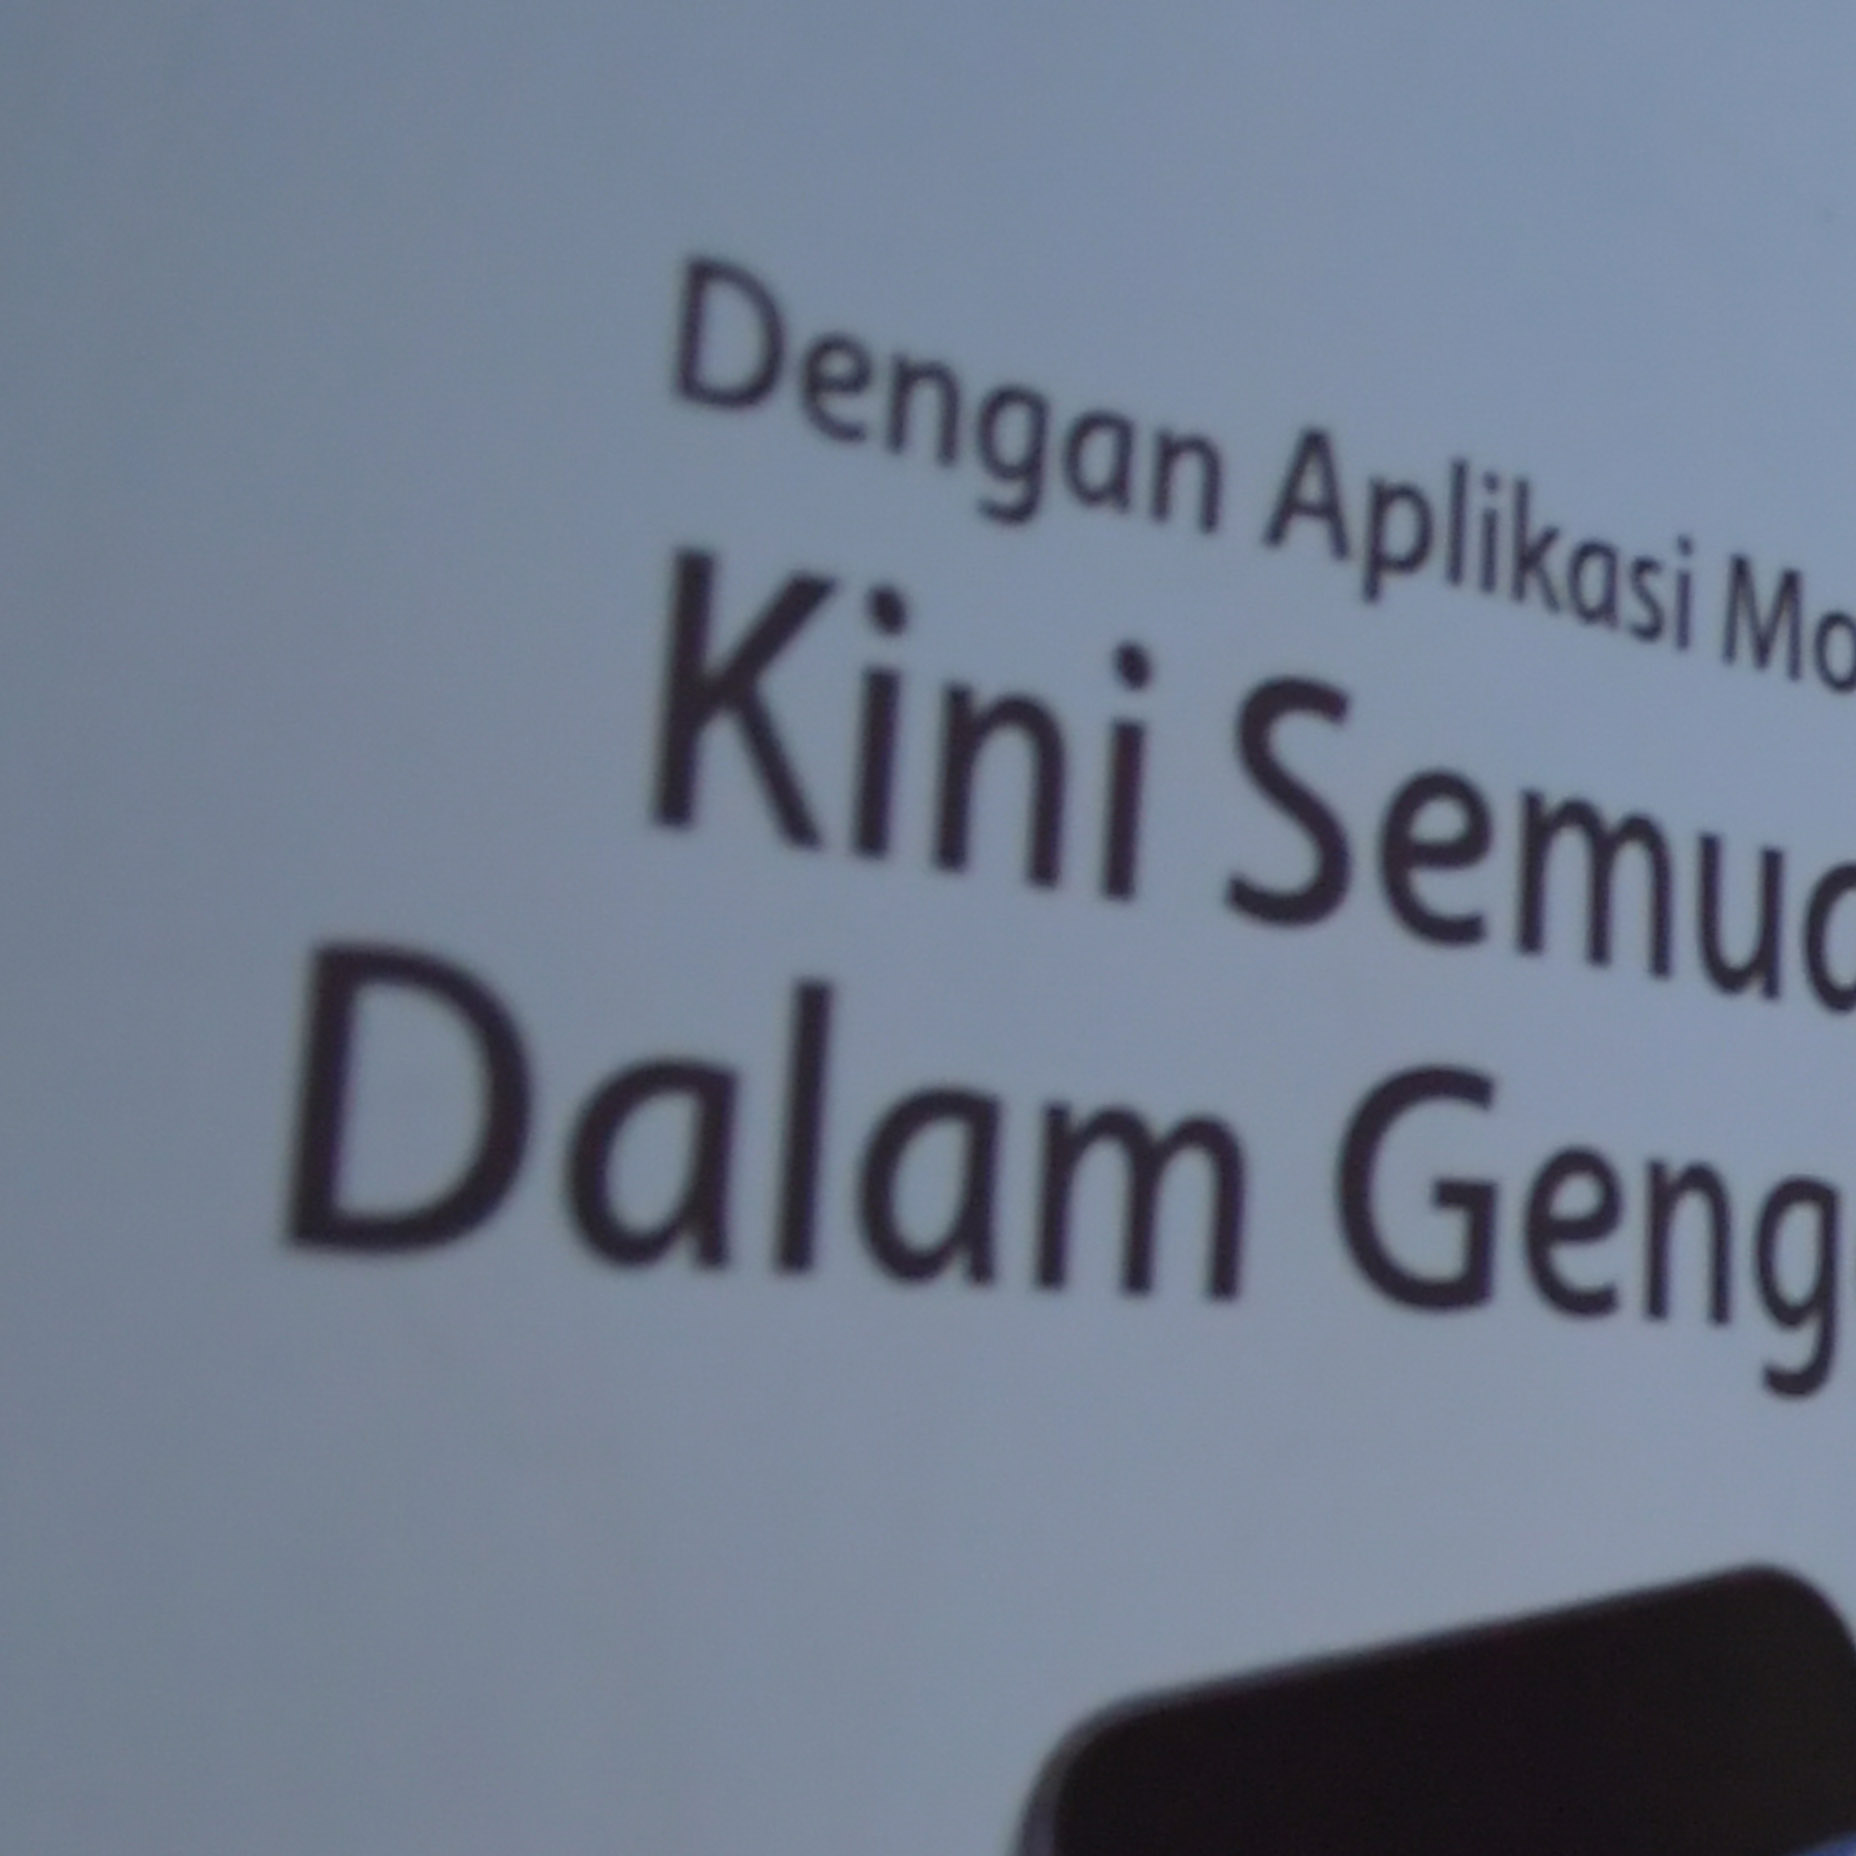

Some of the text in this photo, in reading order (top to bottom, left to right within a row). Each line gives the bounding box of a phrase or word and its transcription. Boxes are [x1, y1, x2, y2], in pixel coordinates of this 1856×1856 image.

[671, 256, 1225, 530] Dengan
[1263, 426, 1698, 652] Aplikasi
[650, 545, 1155, 904] Kini
[282, 938, 1248, 1304] Dalam
